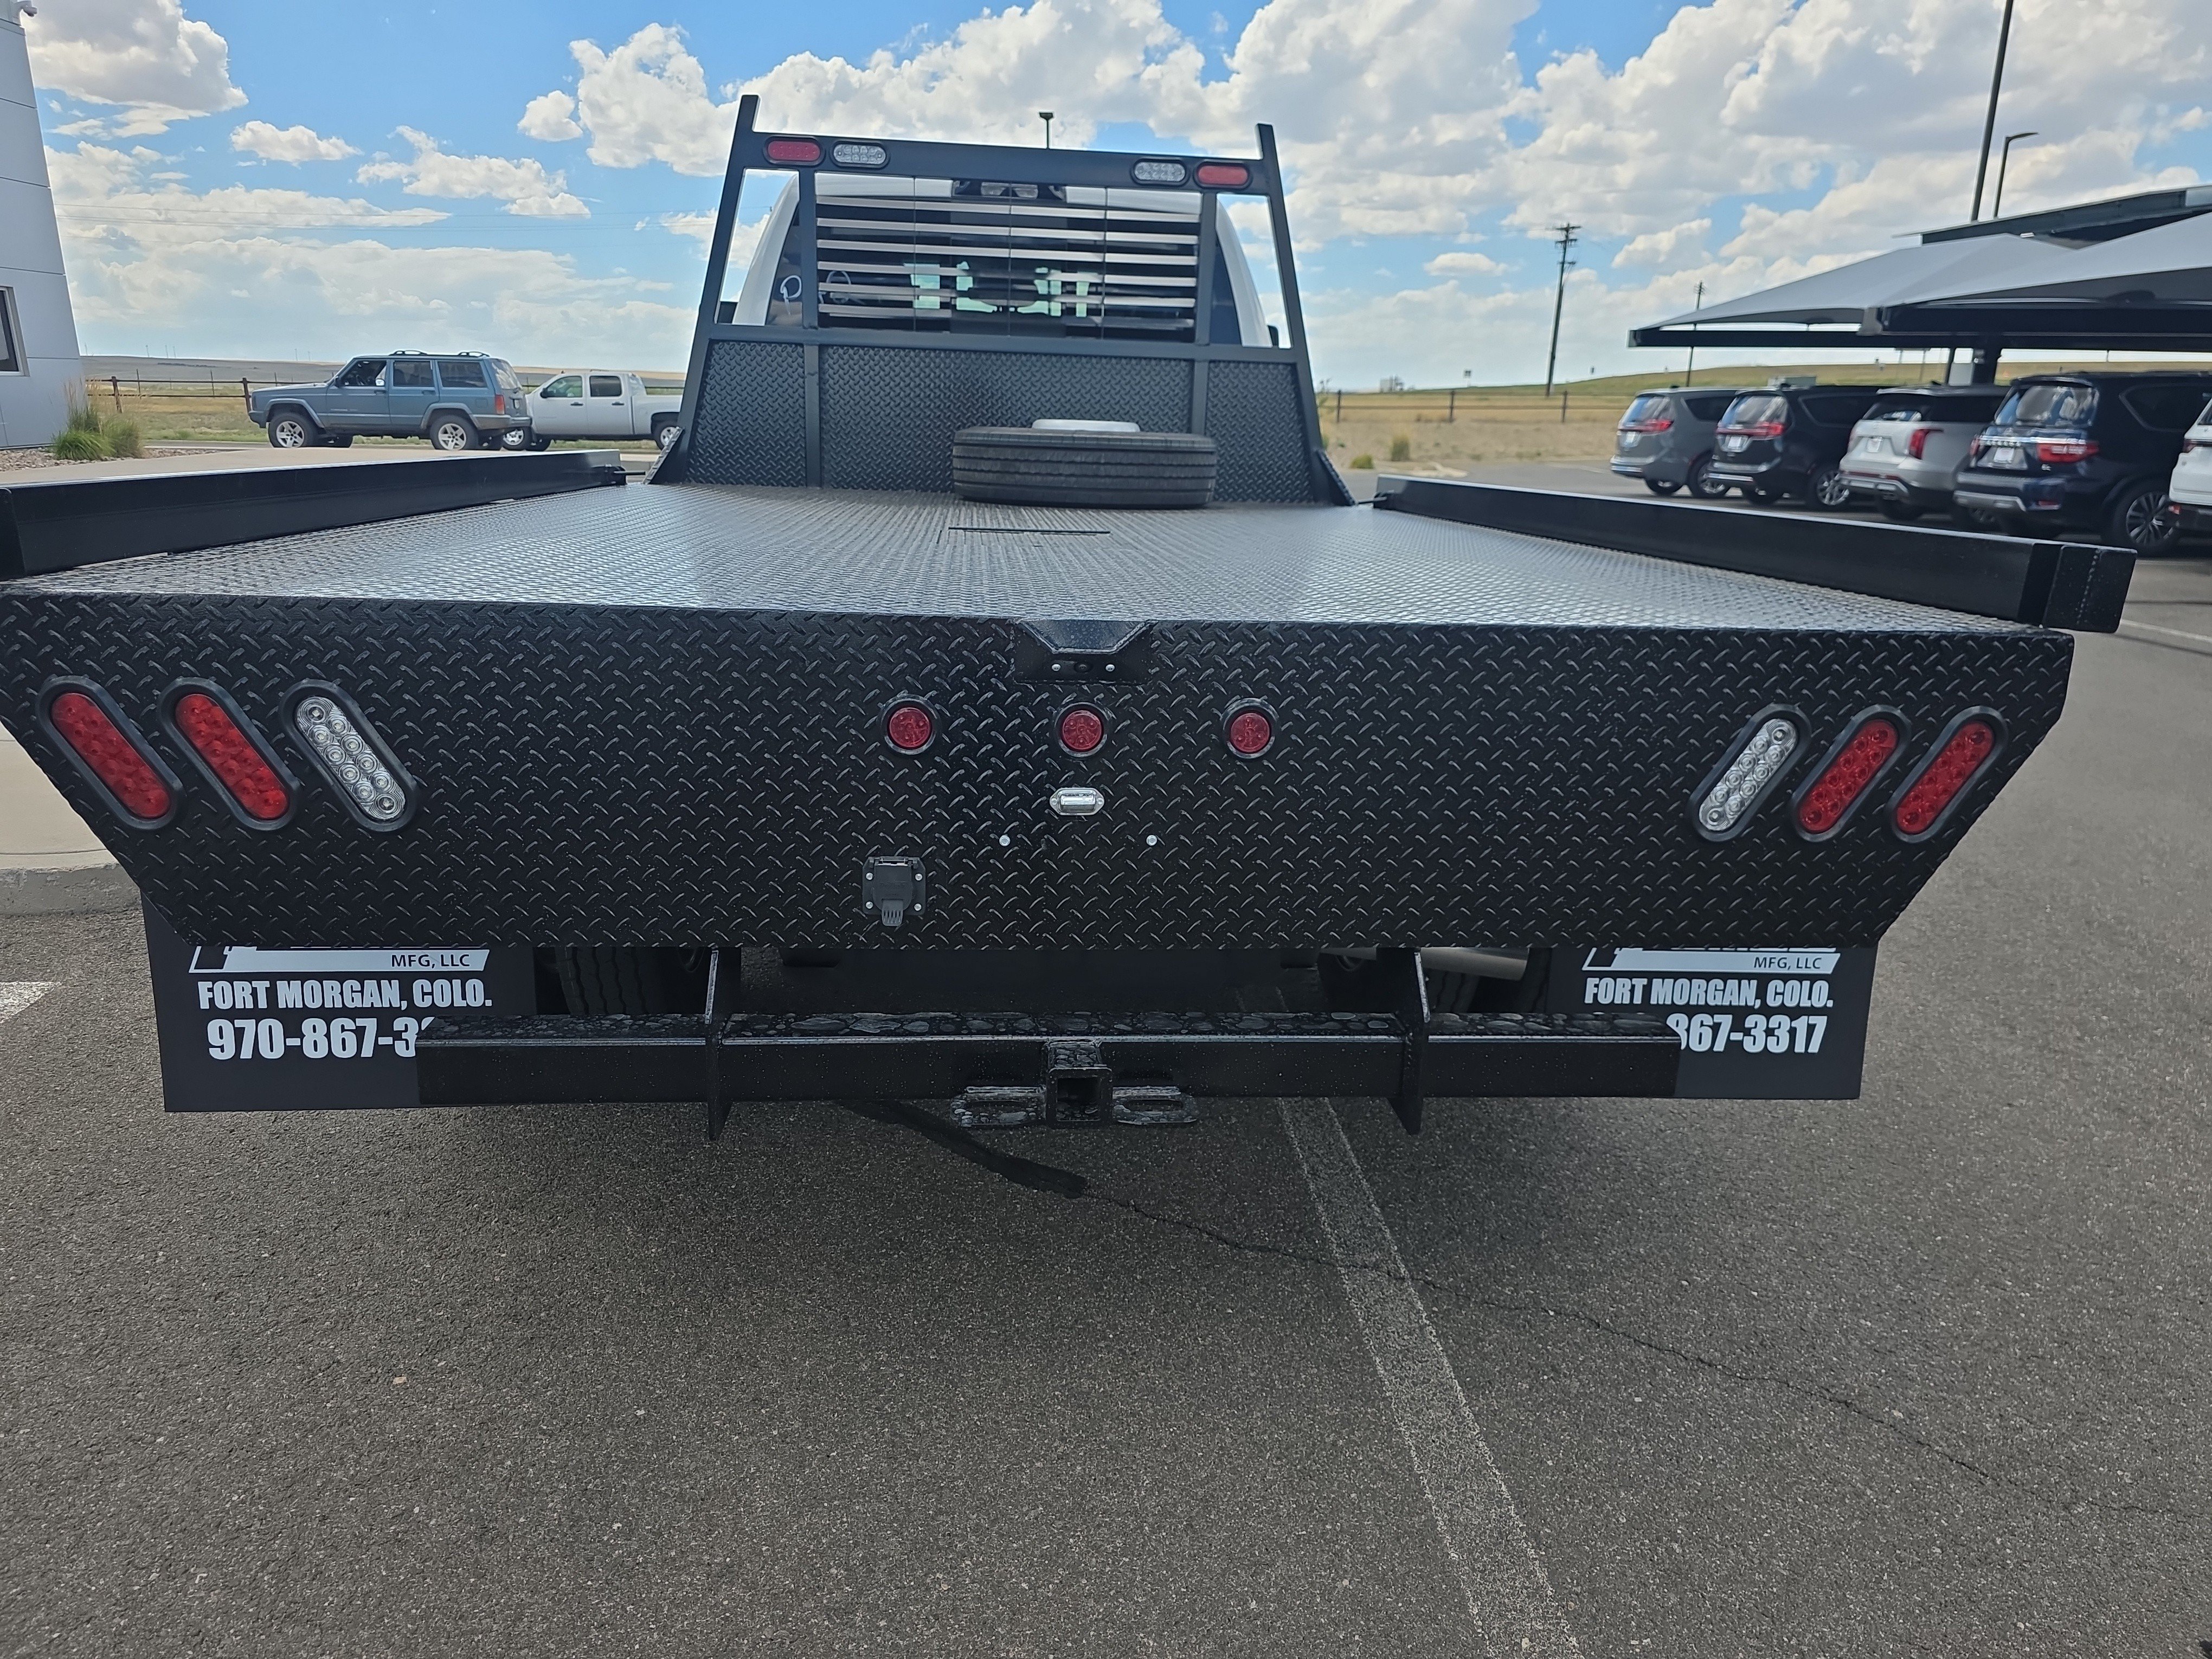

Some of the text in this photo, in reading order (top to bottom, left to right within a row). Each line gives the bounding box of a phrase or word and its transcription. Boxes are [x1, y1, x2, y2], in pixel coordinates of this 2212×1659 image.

[391, 954, 470, 969] MFG, LLC
[1753, 956, 1822, 970] MFG, LLC
[197, 979, 493, 1011] FORT MORGAN, COLO.
[1584, 977, 1834, 1009] FORT MORGAN, COLO.
[207, 1017, 435, 1060] 970-867-3
